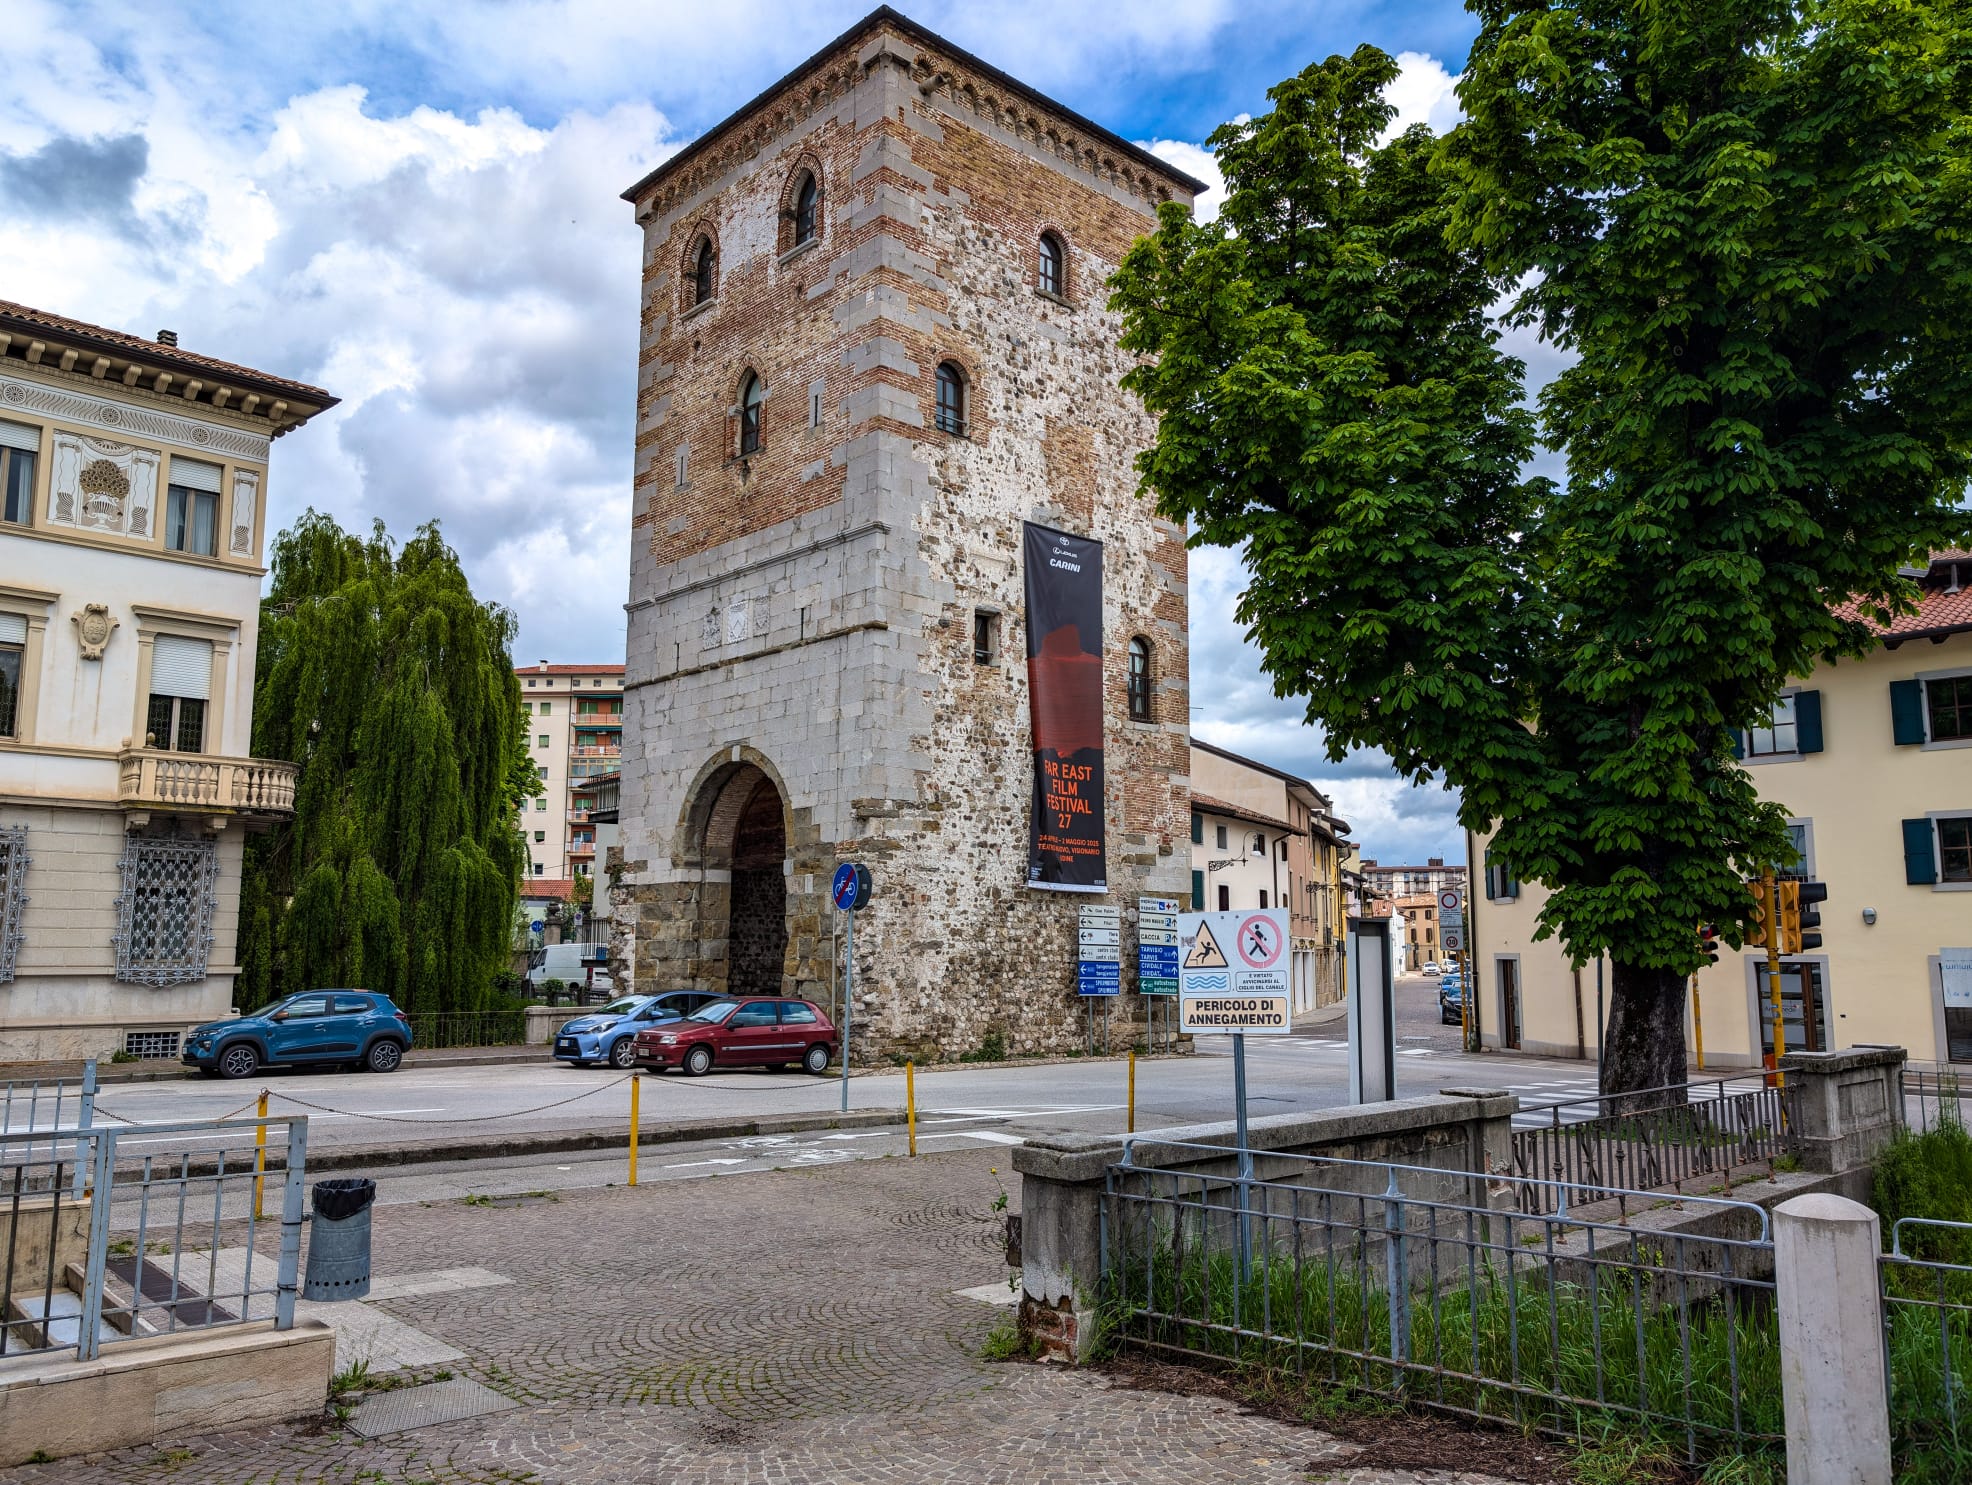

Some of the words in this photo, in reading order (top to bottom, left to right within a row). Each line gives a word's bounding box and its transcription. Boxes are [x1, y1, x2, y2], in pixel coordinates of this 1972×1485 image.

[1050, 558, 1081, 573] CARINI
[1044, 759, 1059, 780] FAR
[1062, 763, 1093, 782] EAST
[1052, 778, 1078, 797] FILM
[1046, 793, 1093, 815] FESTIVAL
[1058, 813, 1072, 829] 27
[1065, 838, 1086, 846] MAGGIO
[1059, 855, 1074, 863] UDINE
[1141, 933, 1160, 941] CACCIA
[1141, 953, 1158, 961] TARVIS
[1141, 962, 1163, 970] CIVIDALE
[1195, 999, 1257, 1011] PERICOLO
[1261, 999, 1274, 1011] DI
[1188, 1013, 1282, 1025] ANNEGAMENTO
